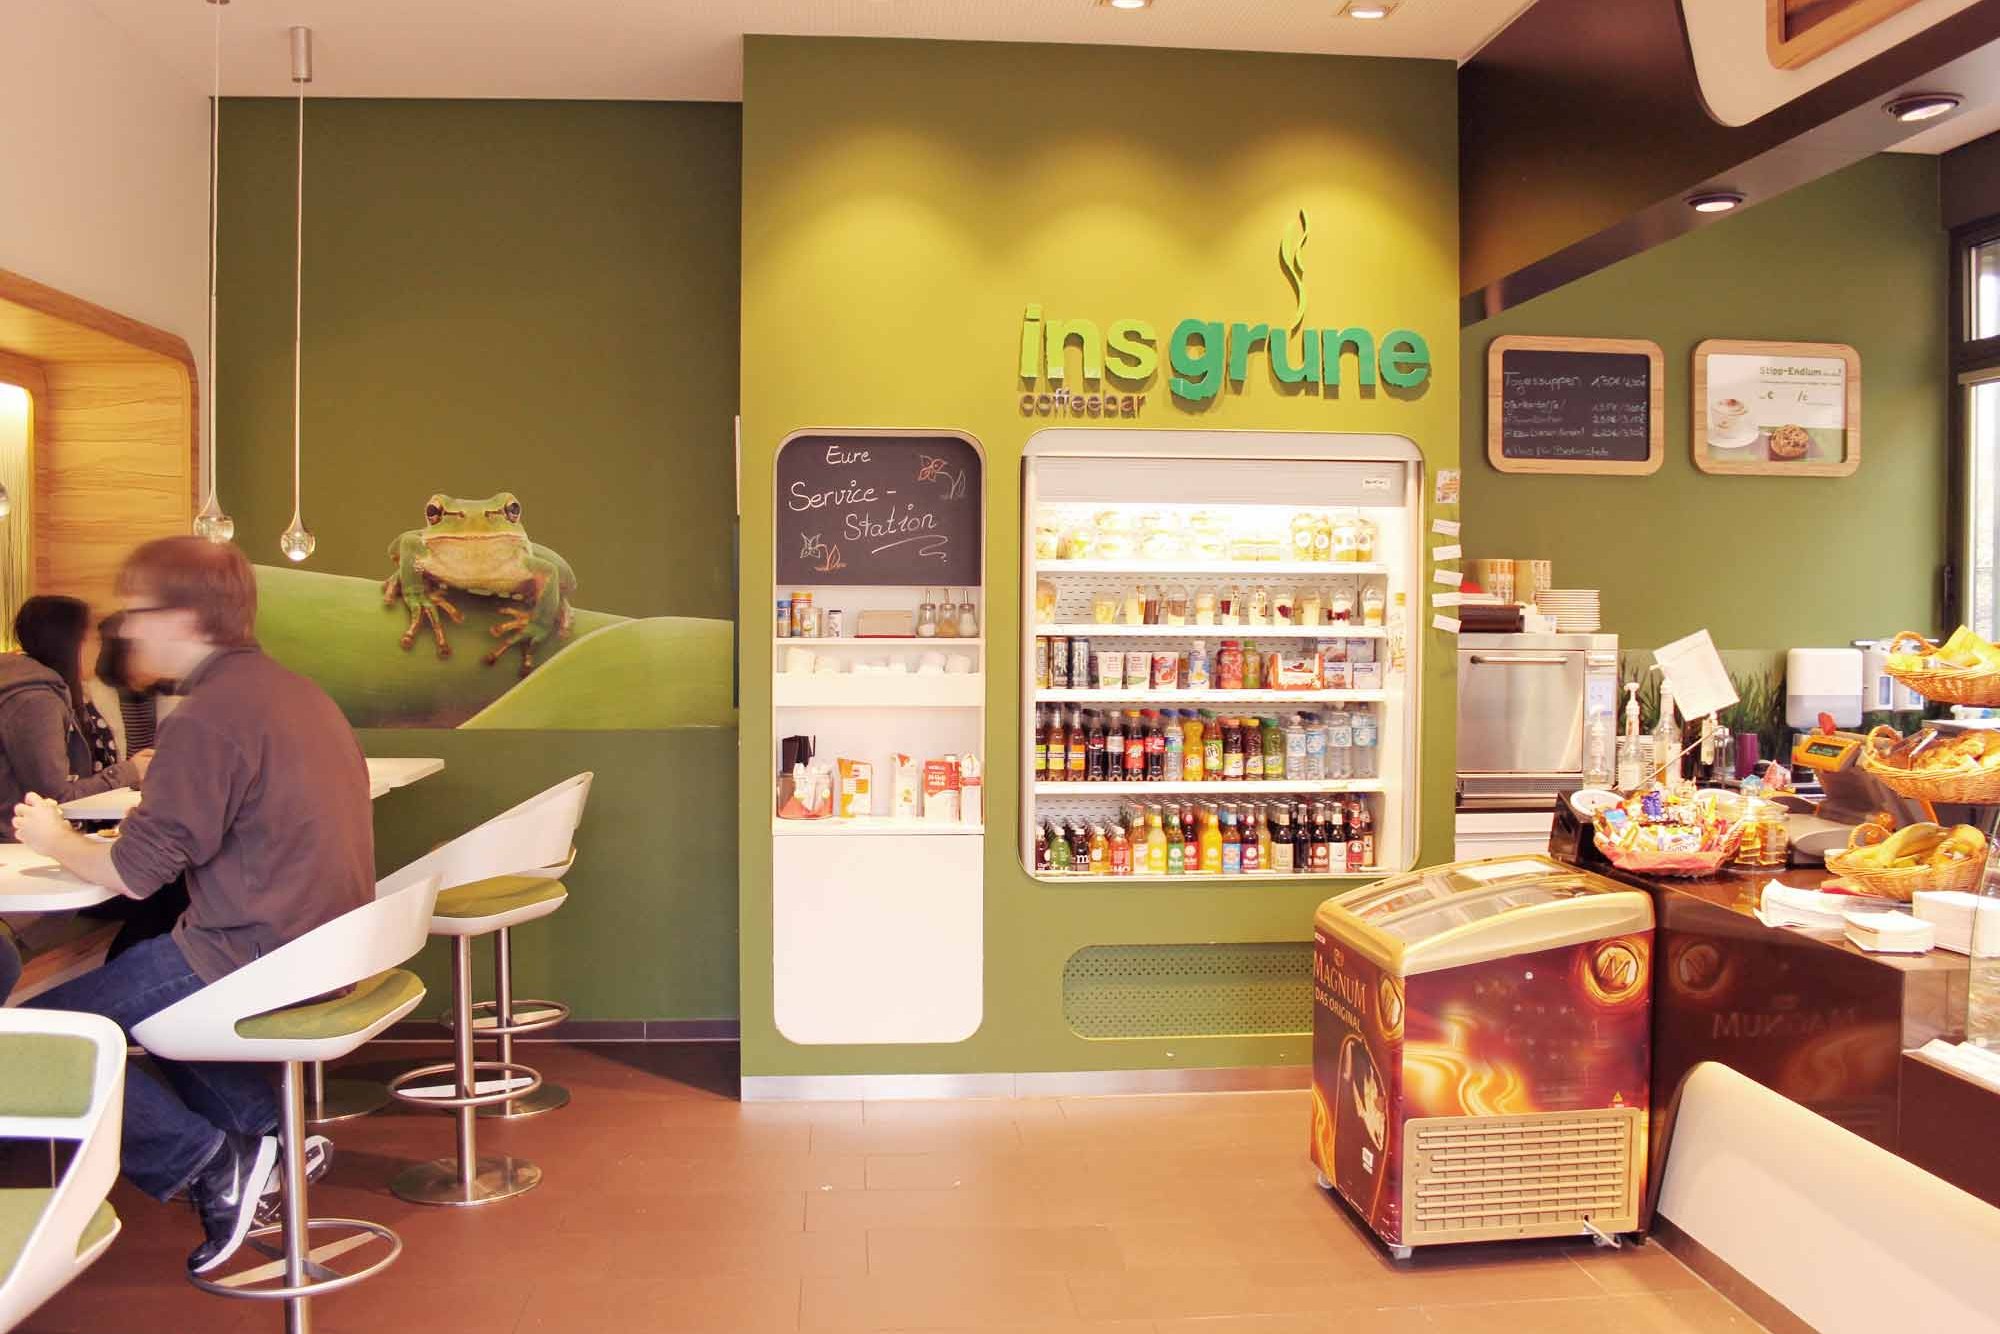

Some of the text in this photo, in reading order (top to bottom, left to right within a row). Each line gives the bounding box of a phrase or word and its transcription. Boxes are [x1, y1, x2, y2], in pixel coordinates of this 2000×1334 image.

[1020, 303, 1158, 380] ins
[1019, 388, 1147, 418] coffeebar
[826, 445, 872, 465] Eure
[788, 479, 879, 512] Service
[843, 503, 938, 541] Station
[1314, 951, 1366, 1014] MAGNUM
